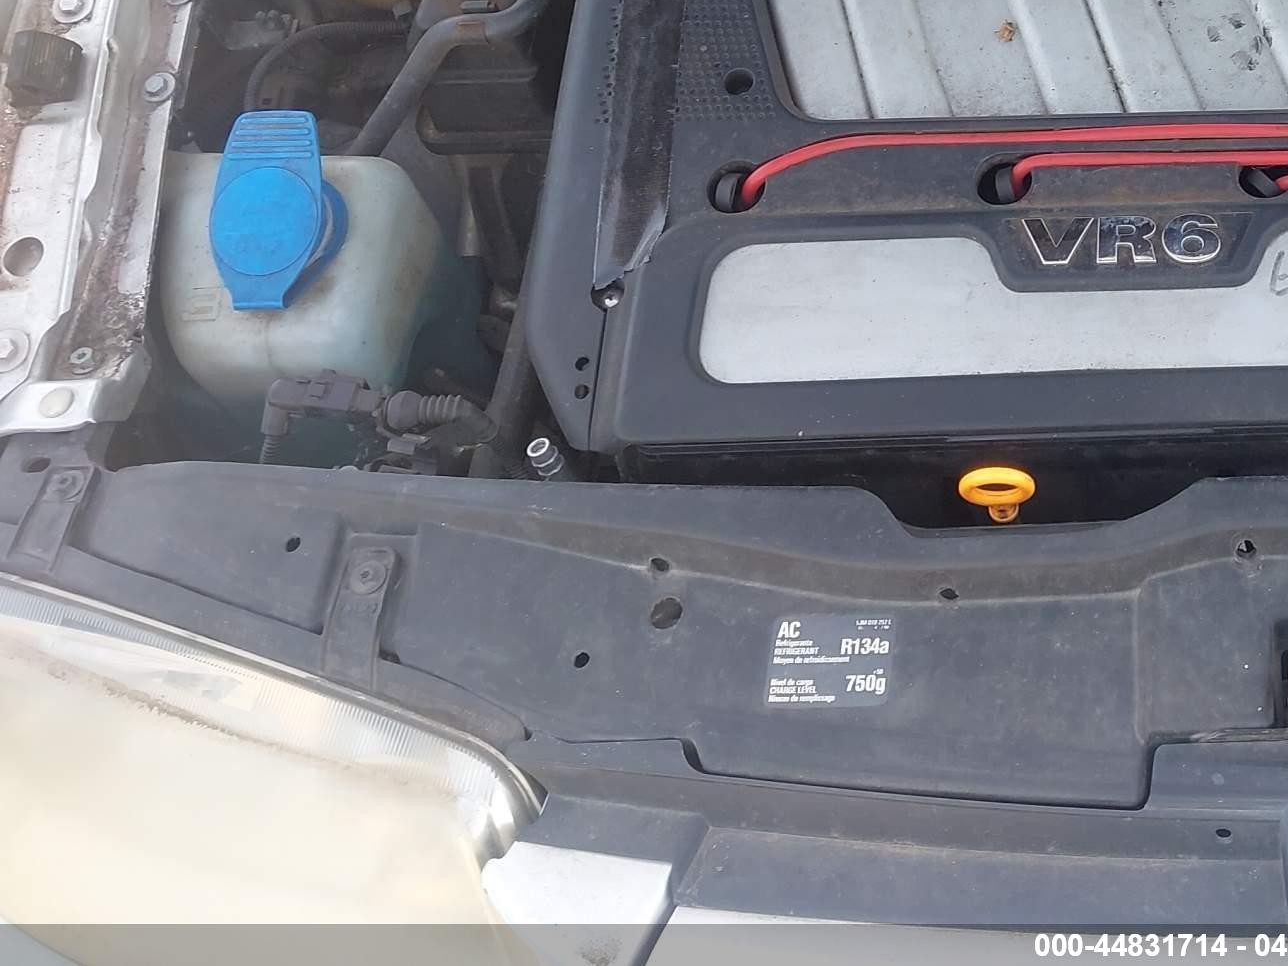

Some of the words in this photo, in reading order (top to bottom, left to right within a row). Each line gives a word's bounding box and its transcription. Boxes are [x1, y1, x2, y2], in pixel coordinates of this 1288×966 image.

[1021, 212, 1221, 266] VR6
[777, 621, 801, 638] AC
[840, 638, 889, 654] R134a
[798, 685, 816, 694] LEVEL
[845, 675, 886, 695] 750g
